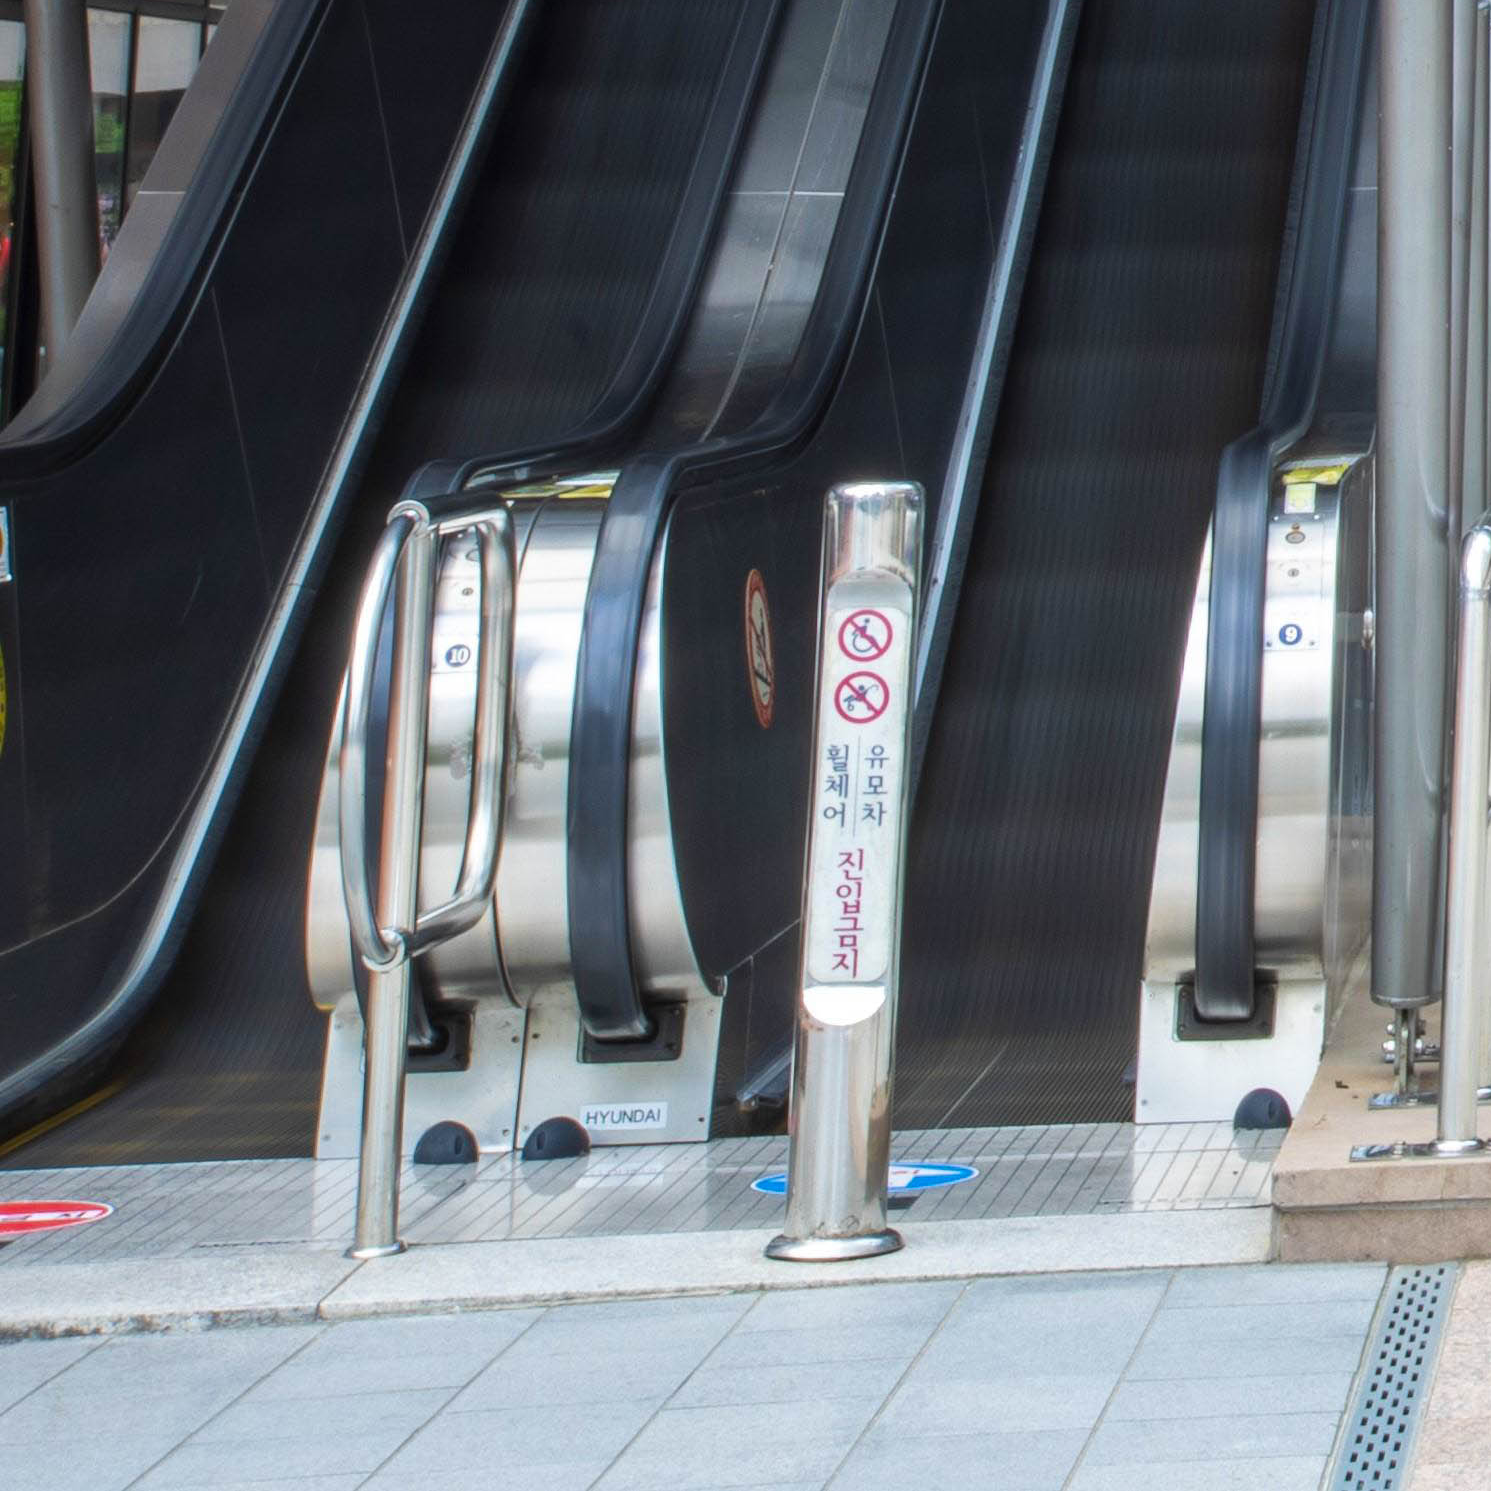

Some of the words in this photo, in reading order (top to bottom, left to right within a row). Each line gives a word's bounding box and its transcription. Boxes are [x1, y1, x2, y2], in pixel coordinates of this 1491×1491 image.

[449, 646, 470, 664] 10
[823, 743, 850, 828] 휠체어
[861, 743, 890, 828] 유모차
[831, 847, 865, 980] 진입금지
[585, 1108, 661, 1125] HYUNDAI
